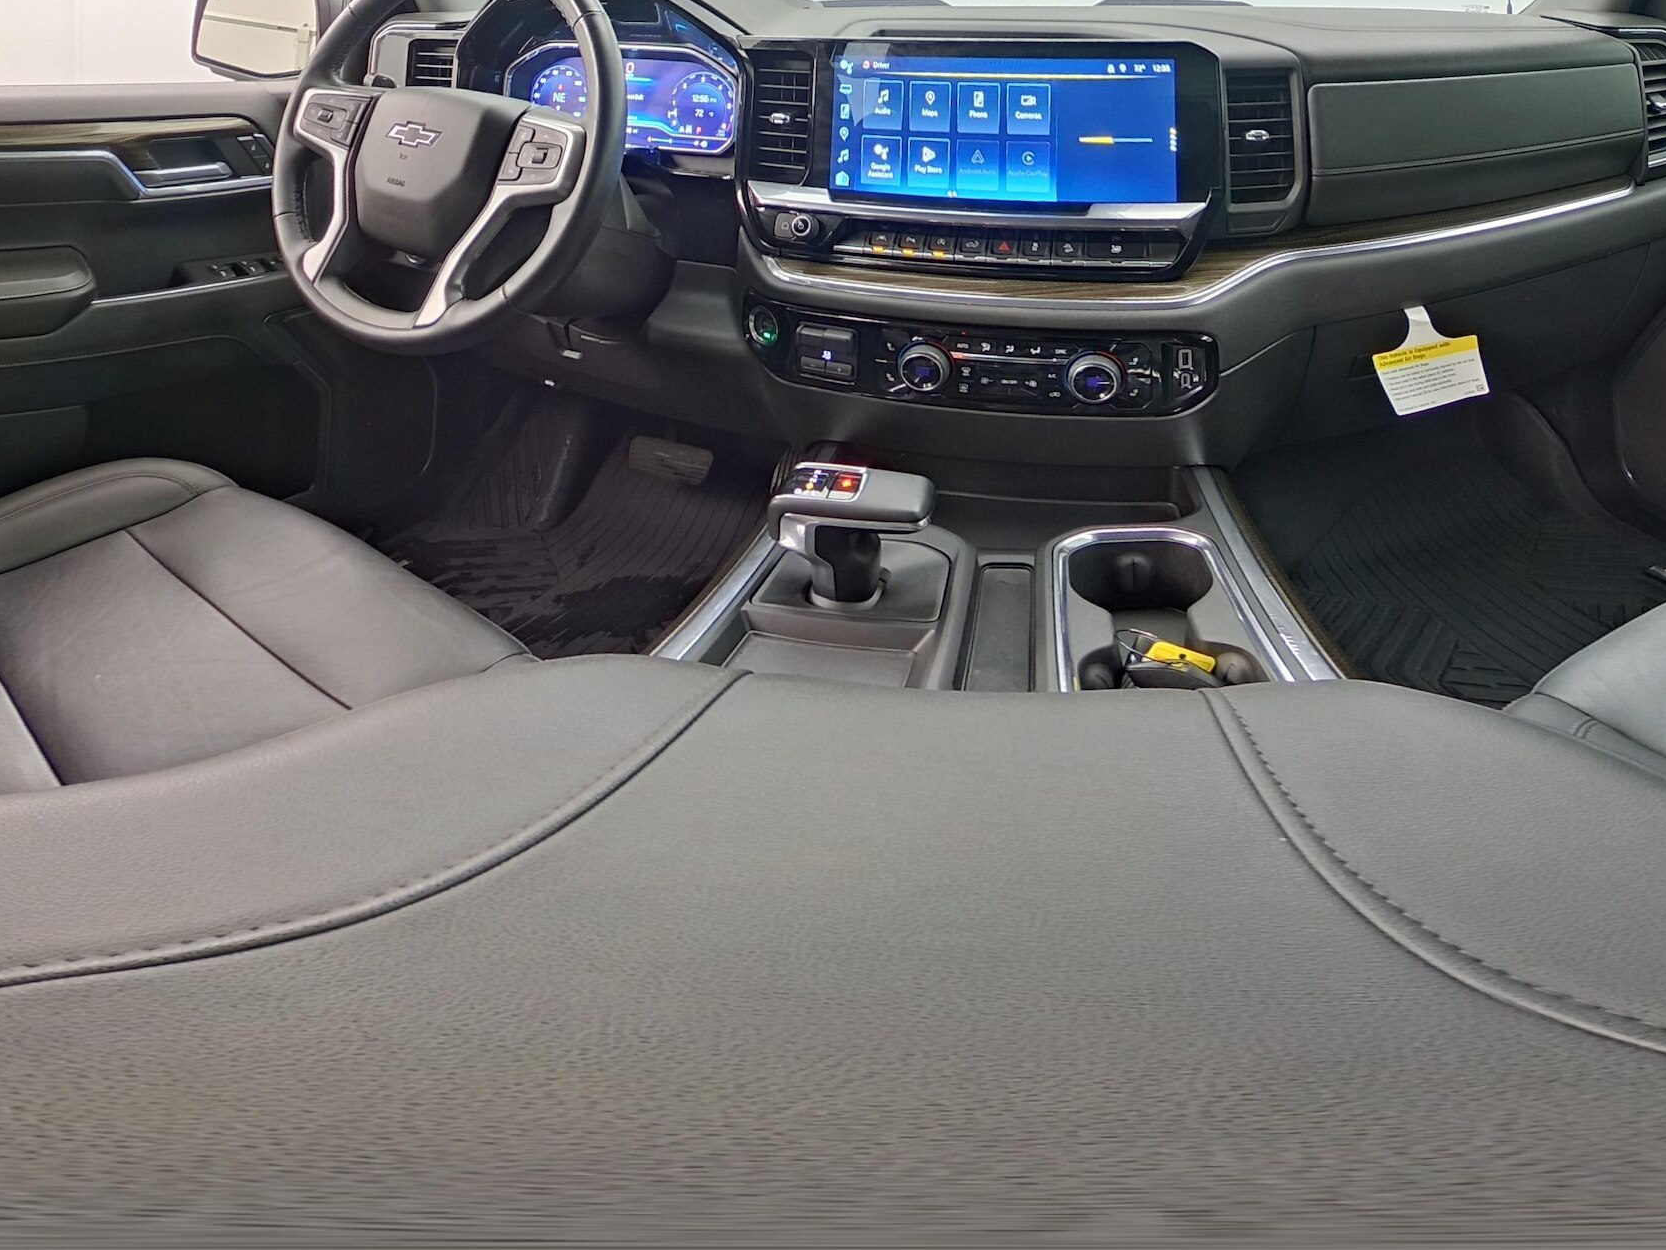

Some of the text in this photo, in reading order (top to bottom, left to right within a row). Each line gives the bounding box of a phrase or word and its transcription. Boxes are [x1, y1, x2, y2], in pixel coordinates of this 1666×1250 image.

[625, 62, 635, 74] 0
[873, 61, 890, 69] Driver
[553, 92, 567, 104] NE
[694, 108, 705, 118] 72
[874, 107, 891, 115] Audio
[921, 108, 938, 118] Maps
[969, 110, 988, 118] Phone
[1015, 111, 1042, 120] Cameras
[870, 162, 891, 172] Google
[914, 164, 942, 174] Play Store
[959, 167, 983, 175] Android
[868, 170, 893, 179] Assistant
[1007, 169, 1048, 178] Apple CarPlay
[387, 177, 405, 187] AIRBAG
[1414, 344, 1438, 355] Equipped
[1379, 358, 1404, 367] Advanced
[1413, 353, 1426, 361] Bags
